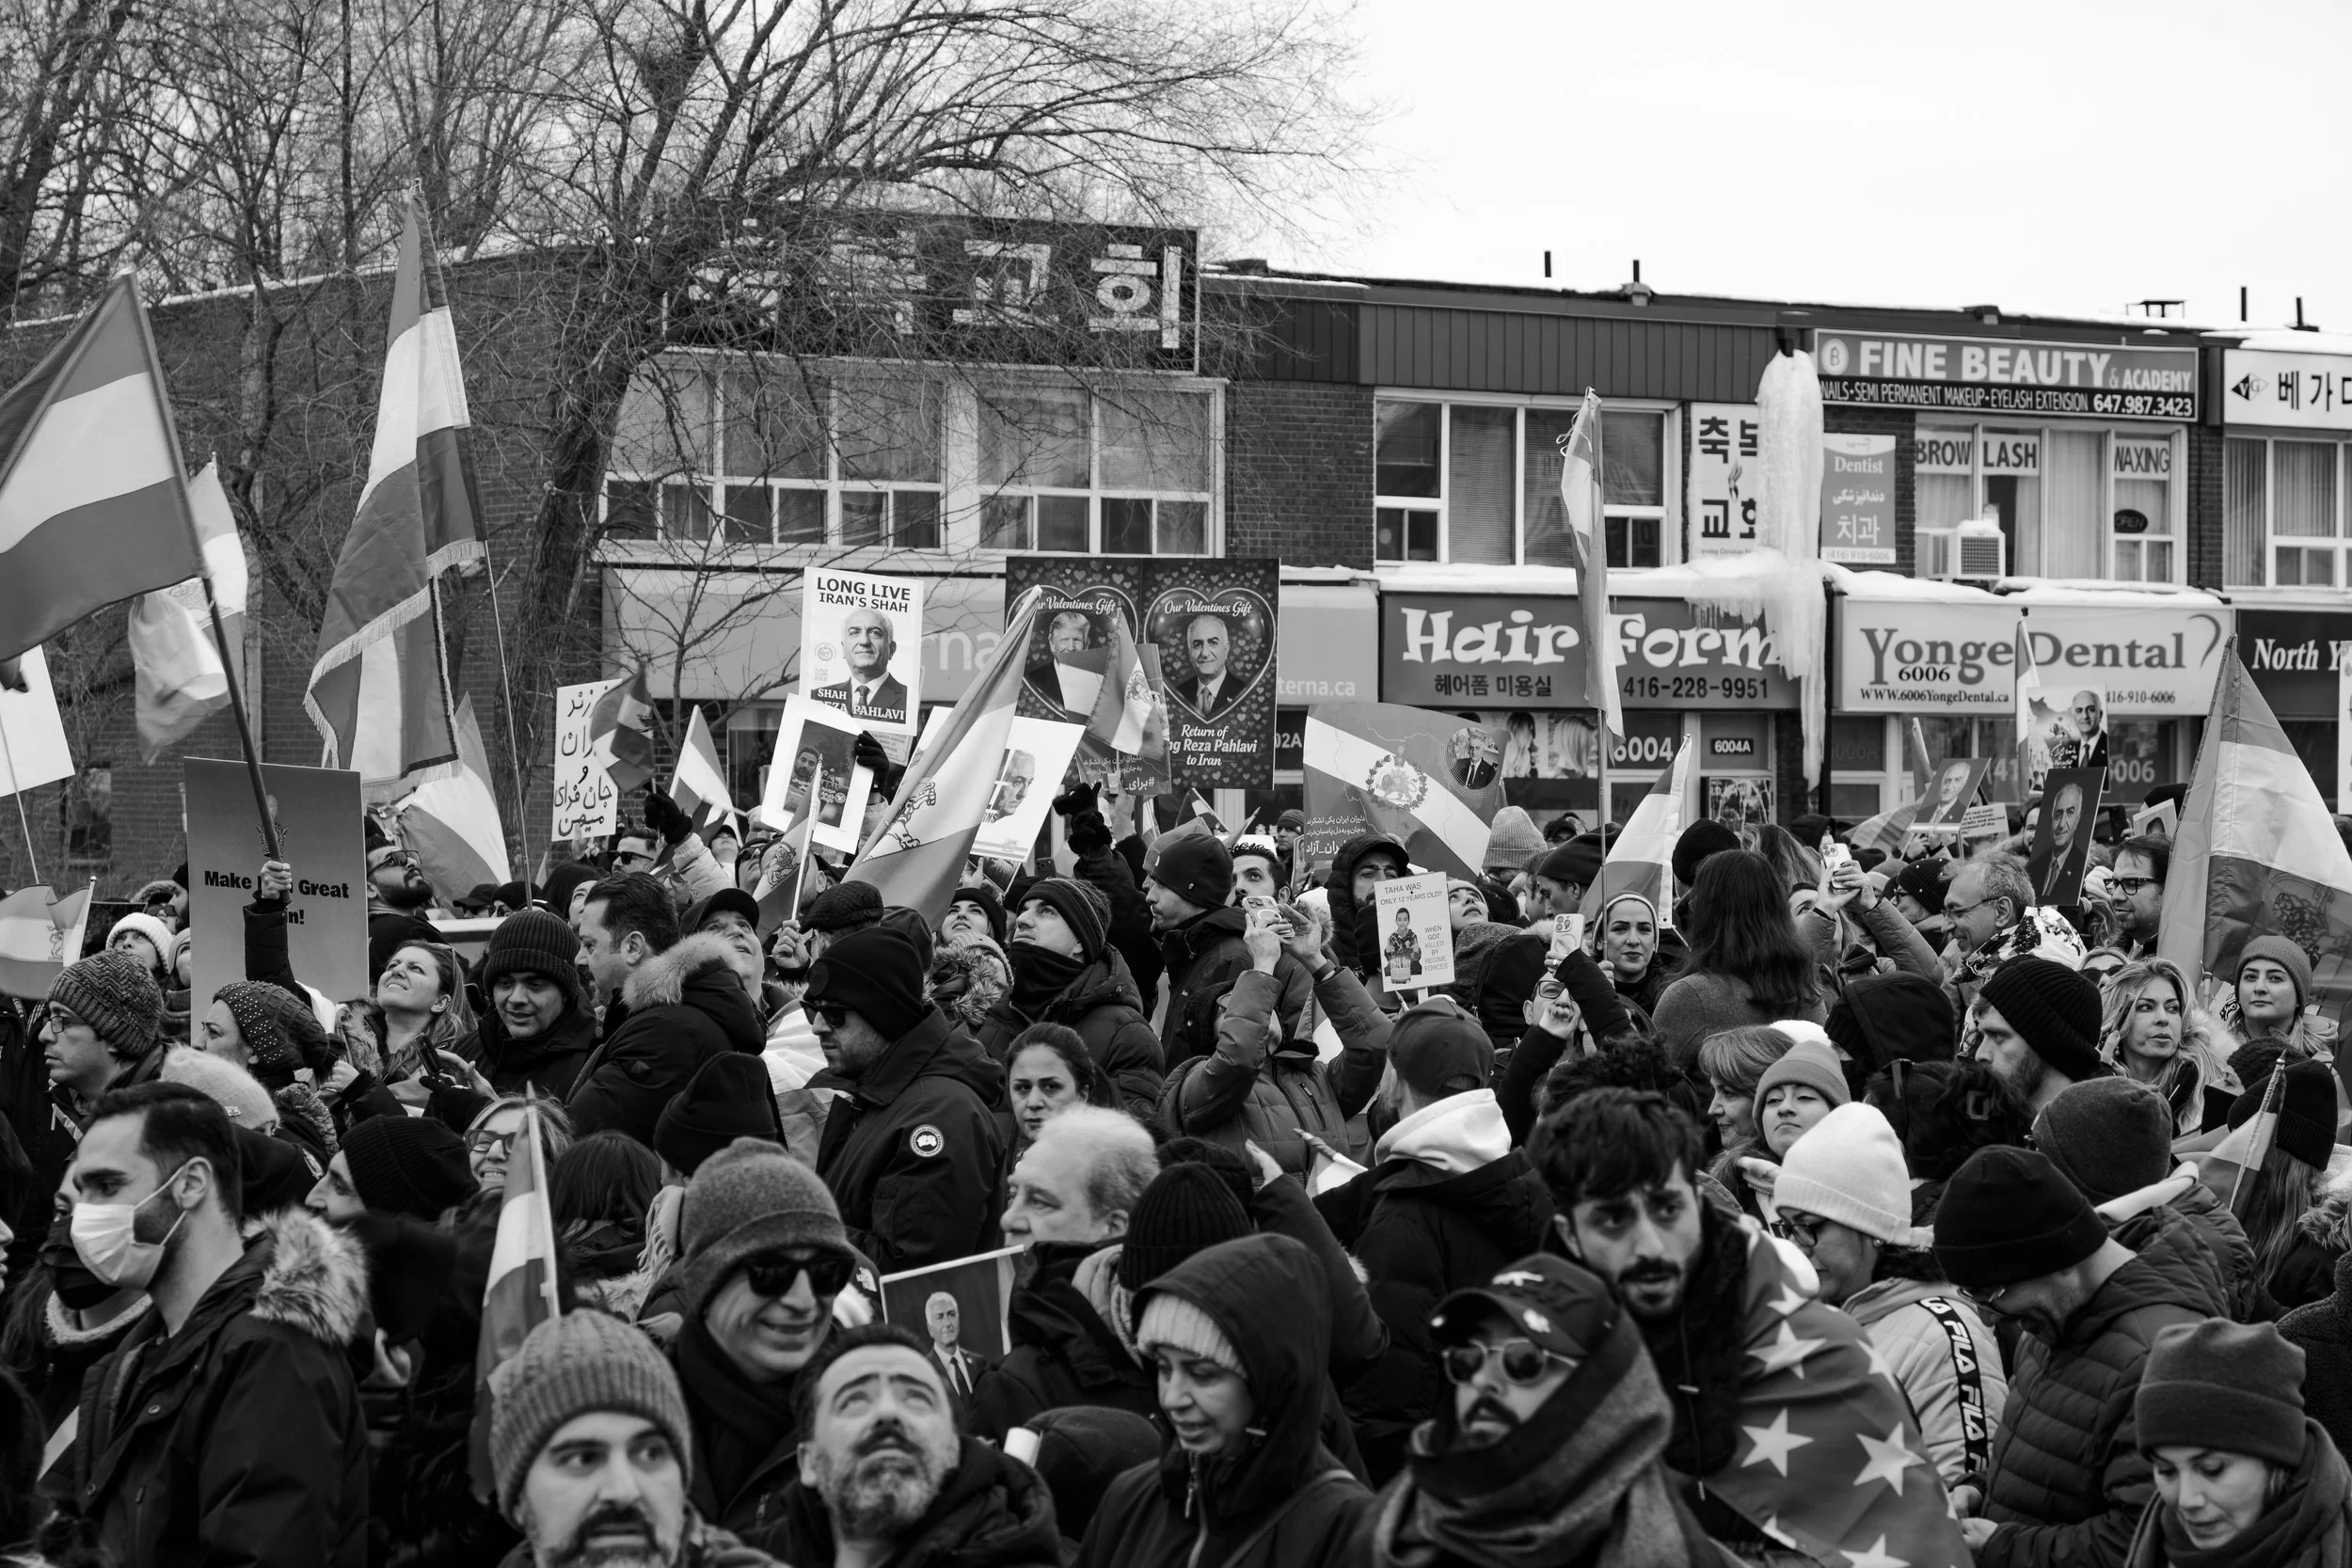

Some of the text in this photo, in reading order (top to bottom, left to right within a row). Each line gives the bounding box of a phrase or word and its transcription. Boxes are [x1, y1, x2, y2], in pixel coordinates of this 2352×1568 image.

[1859, 341, 1947, 379] FINE
[1962, 345, 2111, 388] BEAUTY
[2108, 367, 2120, 389] &
[2122, 368, 2192, 393] ACADEMY
[1820, 381, 2193, 417] NAILS SEMI PERMANENT MAKEUP EYELASH EXTENSION 647.987.3423
[1915, 439, 1971, 467] BROW
[1983, 440, 2037, 468] LASH
[2114, 446, 2169, 473] WAXING
[1834, 455, 1883, 474] Dentist
[1836, 513, 1882, 546] 치과
[817, 577, 911, 601] LONG LIVE
[819, 592, 908, 613] IRAN'S SHAH
[1046, 595, 1094, 611] Valentines
[1095, 597, 1117, 615] Gift
[1164, 598, 1253, 617] Our Valentines Gift
[1400, 607, 1581, 665] Hair
[1859, 627, 2186, 686] Yonge Dental
[2251, 638, 2320, 672] North
[1898, 665, 1951, 682] 6006
[817, 688, 848, 701] SHAH
[1278, 675, 1356, 697] terna.ca
[1434, 673, 1553, 698] 헤어폼 미용실
[1623, 676, 1770, 700] 416-228-9951
[1860, 688, 2010, 705] WWW.6006YongeDental.ca
[852, 705, 905, 721] PAHLAVI
[1181, 723, 1231, 740] Return of
[1274, 732, 1303, 750] 02A
[1183, 739, 1212, 753] Reza
[1214, 738, 1258, 754] Pahlavi
[1714, 739, 1752, 753] 6004A
[1186, 753, 1222, 767] to Iran
[582, 774, 613, 810] جان
[558, 813, 605, 837] میهن
[204, 869, 252, 891] Make
[297, 879, 350, 899] Great
[1384, 881, 1422, 895] TAHA WAS
[1380, 897, 1398, 906] ONLY
[1398, 895, 1406, 904] 12
[1406, 893, 1426, 902] YEARS
[1423, 925, 1442, 934] WHEN
[1427, 932, 1440, 941] GOT
[1424, 940, 1445, 949] KILLED
[1431, 948, 1440, 957] BY
[1424, 955, 1447, 964] REGIME
[1424, 962, 1449, 973] FORCES
[1943, 1320, 1977, 1374] FILA
[1962, 1384, 1985, 1441] FILA
